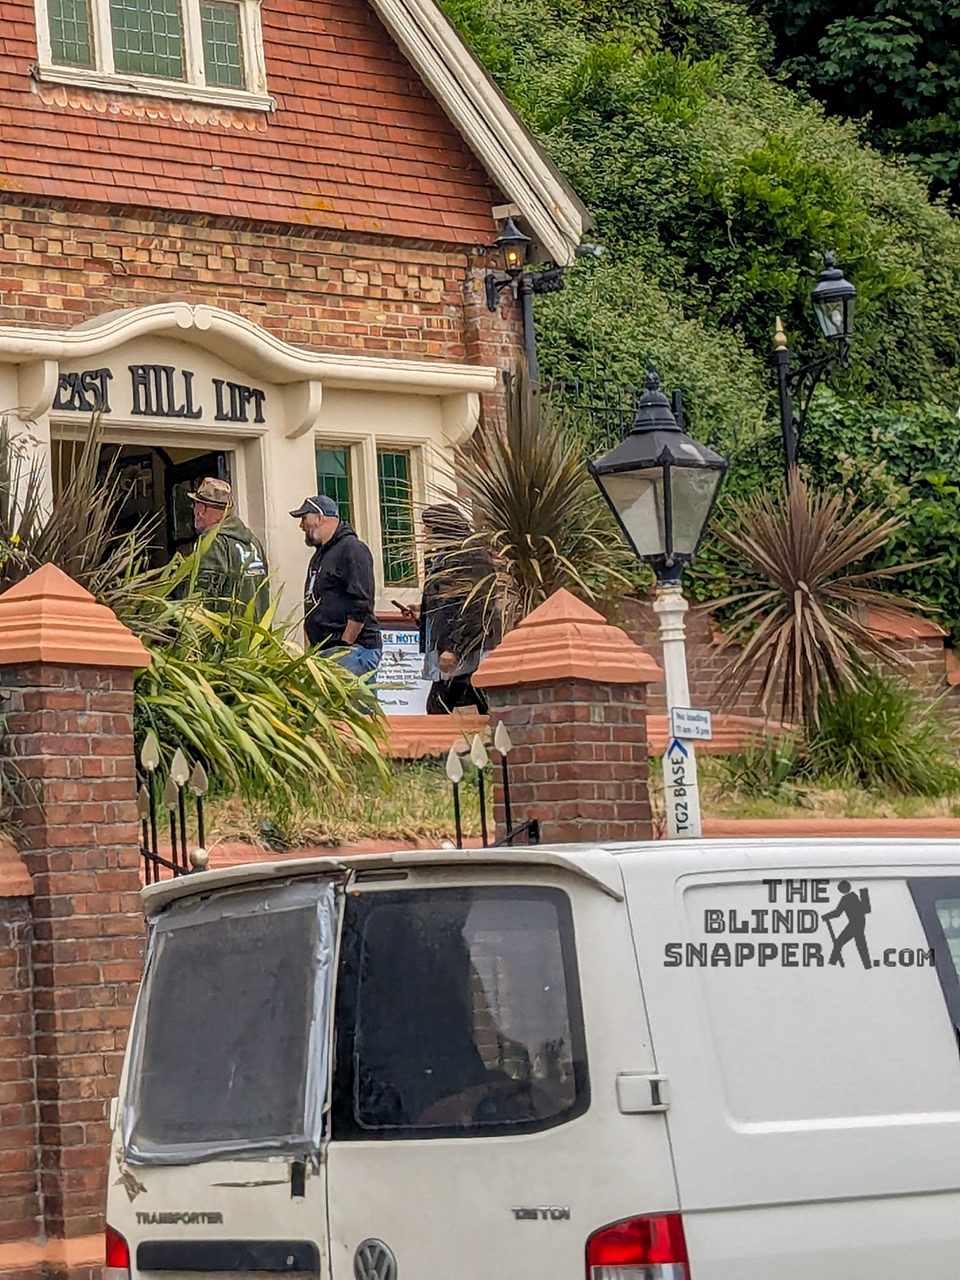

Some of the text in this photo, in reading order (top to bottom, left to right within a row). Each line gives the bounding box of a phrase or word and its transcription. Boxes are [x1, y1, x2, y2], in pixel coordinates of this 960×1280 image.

[52, 365, 266, 423] EAST HILL LIFT
[671, 756, 689, 834] TG2 BASE
